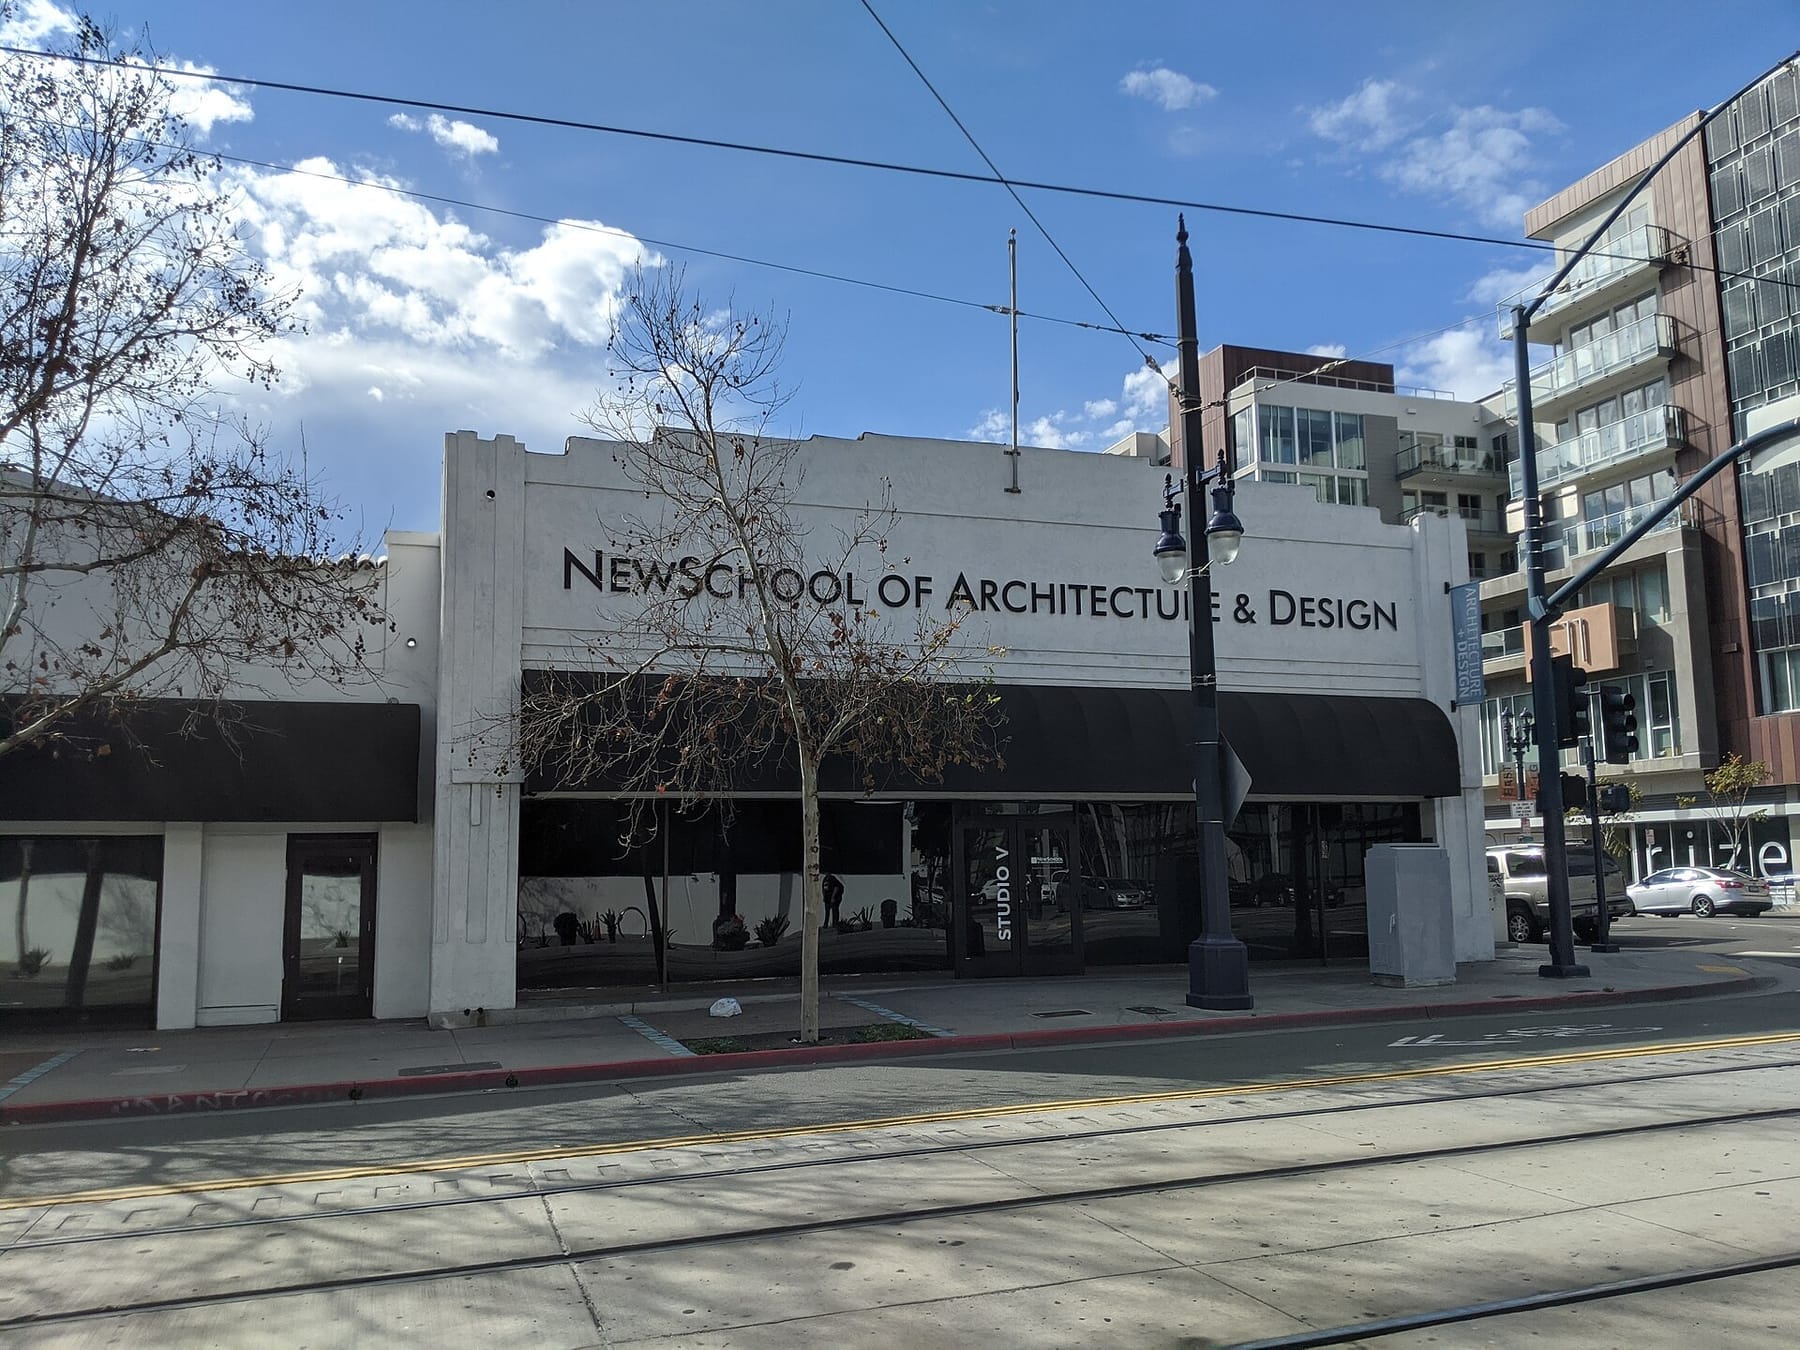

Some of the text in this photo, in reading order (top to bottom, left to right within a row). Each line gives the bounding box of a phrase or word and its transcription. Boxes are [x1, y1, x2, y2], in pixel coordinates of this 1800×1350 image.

[878, 573, 933, 608] OF
[1233, 593, 1257, 624] &
[1269, 589, 1398, 632] DESIGN
[1456, 640, 1471, 698] DESIGN
[1464, 587, 1481, 698] ARCHITECTURE
[995, 846, 1012, 941] STUDIO V
